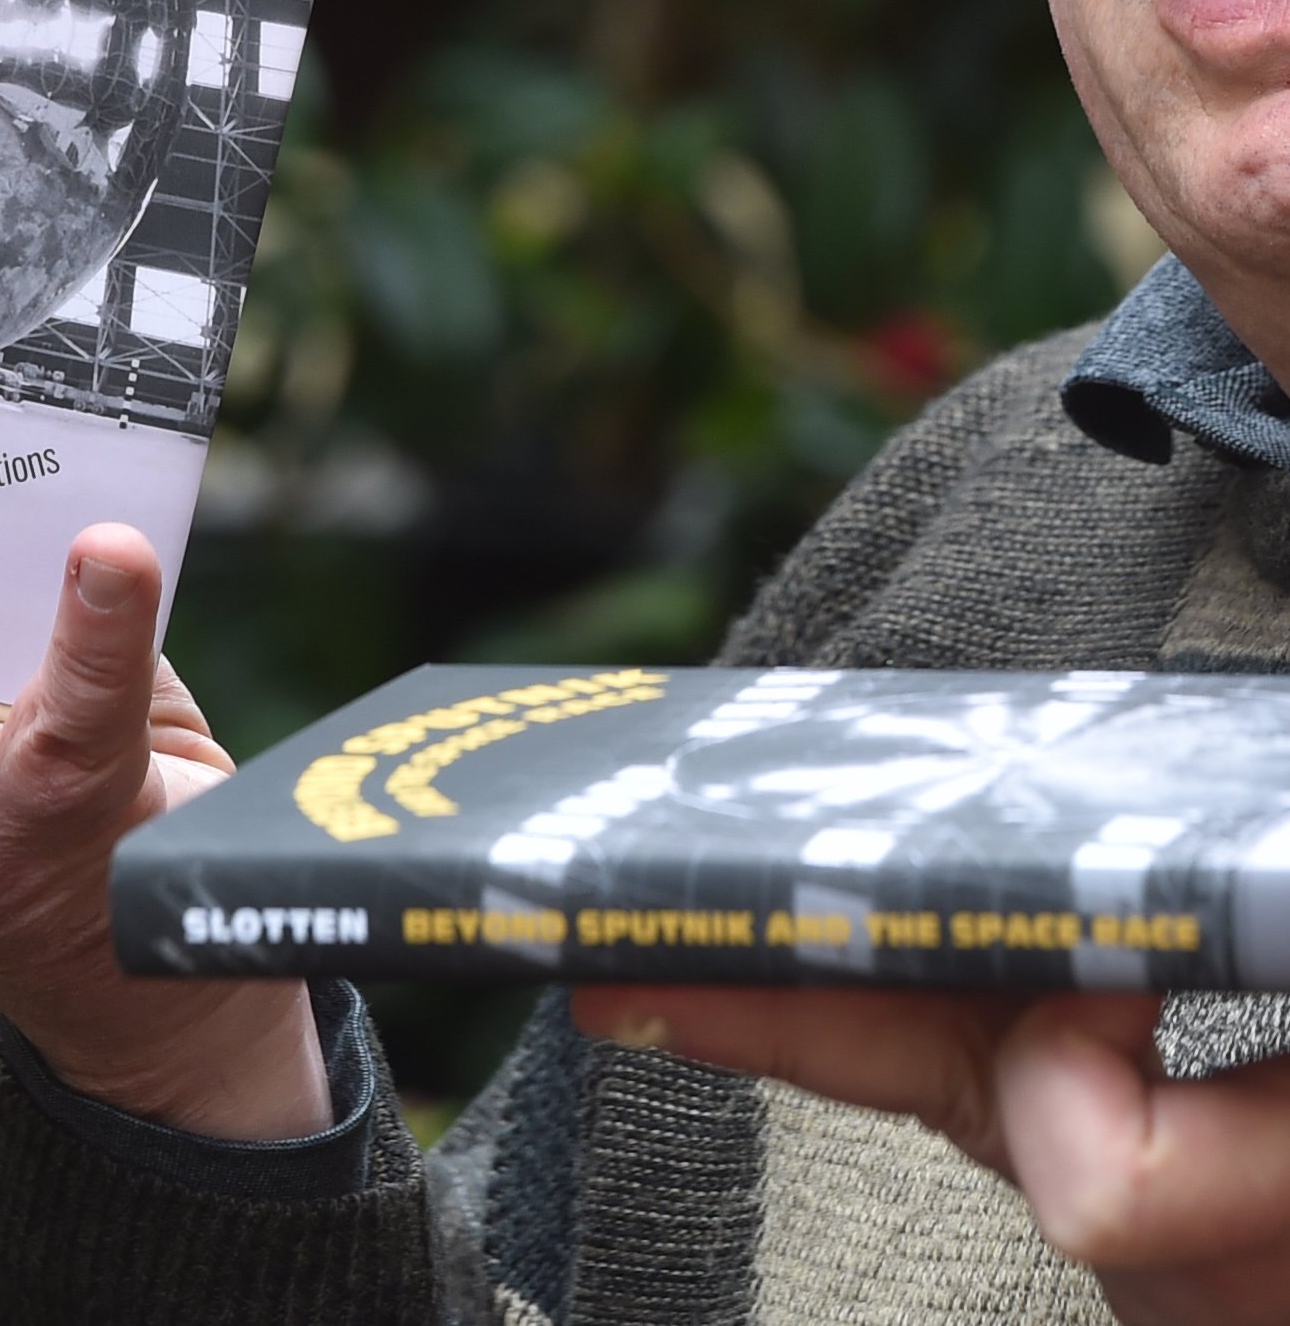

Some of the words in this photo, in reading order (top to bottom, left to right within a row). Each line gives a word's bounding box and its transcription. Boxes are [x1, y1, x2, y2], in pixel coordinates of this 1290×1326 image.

[182, 906, 369, 945] SLOTTEN
[402, 908, 568, 945] BEYOND
[575, 909, 755, 946] SPUTNIK
[766, 910, 852, 947] AND
[864, 911, 942, 949] THE
[950, 911, 1082, 949] SPACE
[1091, 912, 1202, 952] RACE
